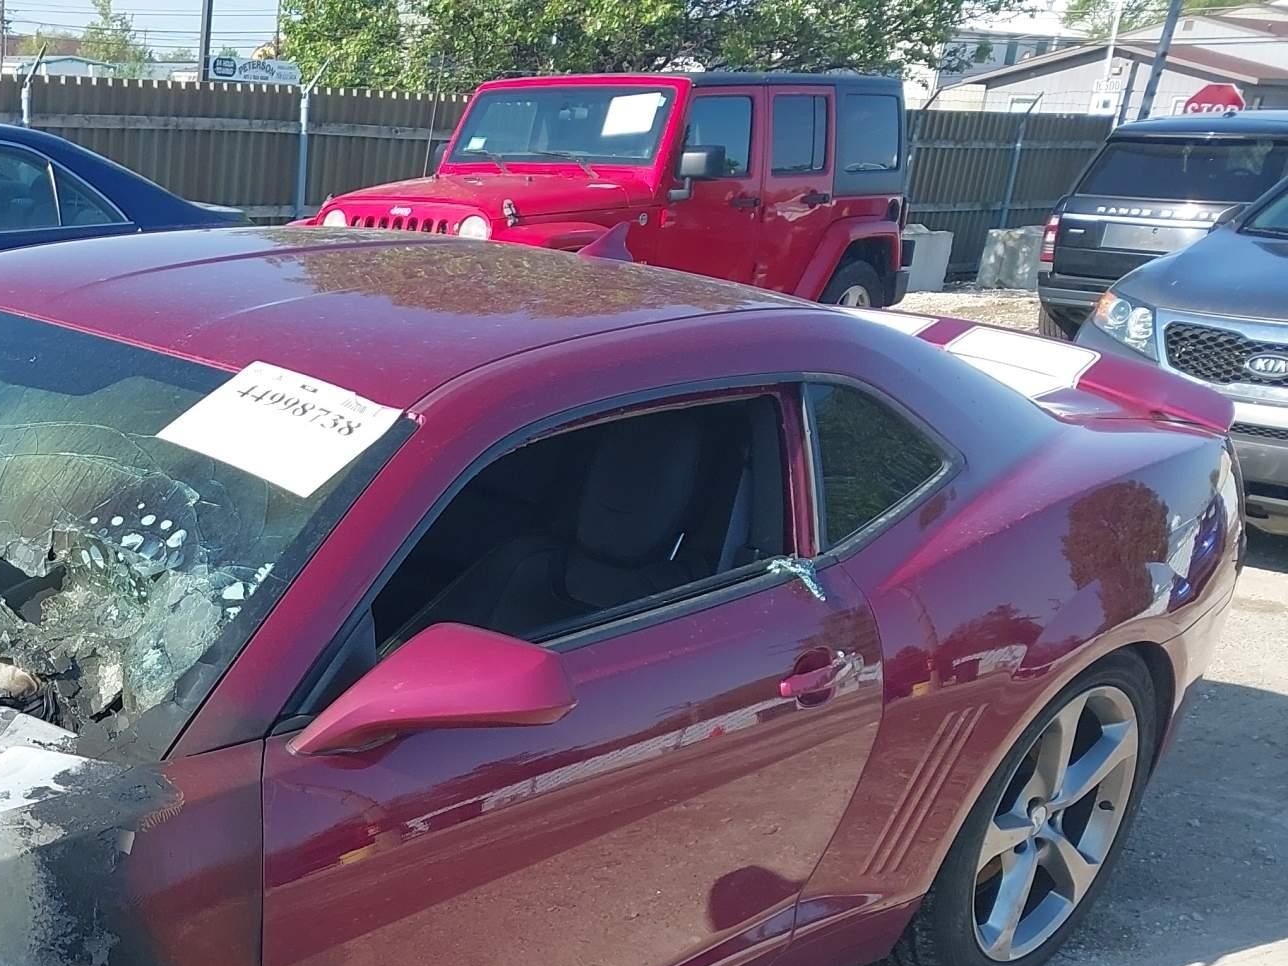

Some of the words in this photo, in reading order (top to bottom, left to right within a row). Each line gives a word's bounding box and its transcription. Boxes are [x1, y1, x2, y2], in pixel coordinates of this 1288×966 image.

[238, 60, 276, 76] PETERSON
[1255, 358, 1286, 372] KIA
[236, 384, 362, 437] 44998738
